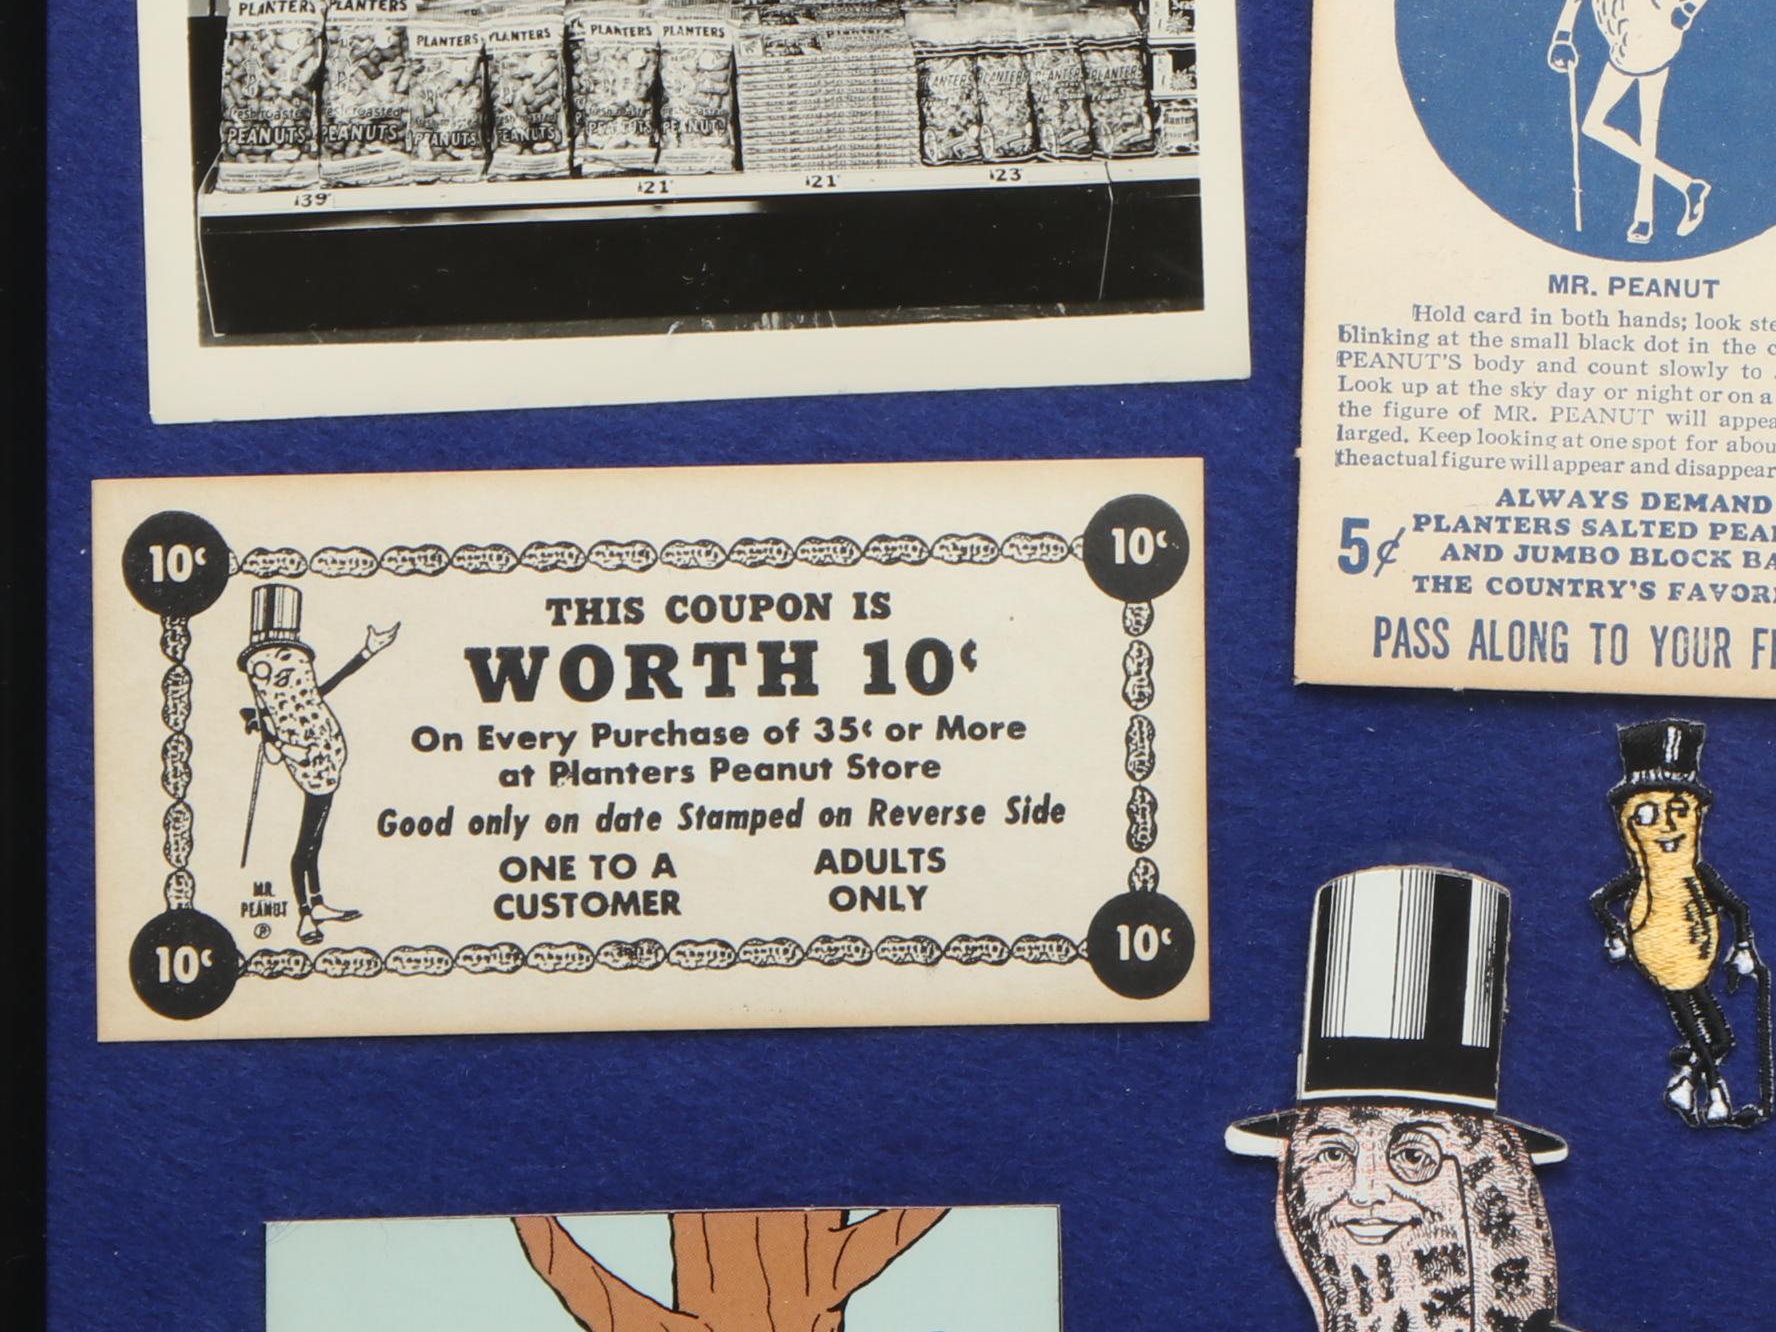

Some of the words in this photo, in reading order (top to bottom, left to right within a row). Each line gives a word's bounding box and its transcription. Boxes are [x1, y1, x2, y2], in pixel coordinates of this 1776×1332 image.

[228, 125, 306, 144] PEANUTS
[1547, 273, 1598, 297] MR.
[1607, 275, 1721, 300] PEANUT
[1411, 303, 1466, 323] Hold
[1473, 306, 1522, 325] card
[1530, 307, 1553, 326] in
[1560, 307, 1610, 328] both
[1617, 309, 1687, 331] hands;
[1695, 312, 1742, 332] look
[1337, 323, 1430, 347] blinking
[1437, 330, 1459, 347] at
[1468, 329, 1504, 349] the
[1510, 331, 1569, 350] small
[1578, 332, 1635, 352] black
[1643, 334, 1680, 354] dot
[1687, 336, 1709, 354] in
[1722, 337, 1757, 356] the
[1494, 487, 1629, 511] ALWAYS
[1639, 491, 1773, 515] DEMAND
[1411, 513, 1571, 537] PLANTERS
[1580, 518, 1699, 540] SALTED
[1439, 542, 1505, 563] AND
[1512, 543, 1621, 566] JUMBO
[1628, 546, 1733, 570] BLOCK
[1411, 574, 1473, 595] THE
[1485, 576, 1657, 601] COUNTRY'S
[544, 595, 646, 628] THIS
[664, 591, 834, 625] COUPON
[851, 590, 893, 621] IS
[1372, 615, 1451, 661] PASS
[1467, 618, 1569, 665] ALONG
[1588, 621, 1629, 667] TO
[1649, 624, 1732, 670] YOUR
[463, 638, 820, 704] WORTH
[410, 724, 464, 754] On
[476, 723, 579, 754] Every
[590, 718, 750, 749] Purchase
[762, 716, 801, 746] of
[884, 721, 924, 743] or
[935, 714, 1028, 742] More
[497, 763, 536, 789] at
[548, 758, 696, 789] Planters
[709, 756, 834, 784] Peanut
[846, 752, 942, 781] Store
[376, 804, 456, 839] Good
[467, 802, 531, 842] only
[543, 812, 580, 835] on
[594, 800, 663, 834] date
[676, 796, 806, 837] Stamped
[817, 805, 853, 829] on
[867, 796, 987, 828] Reverse
[1003, 791, 1067, 826] Side
[498, 854, 577, 884] ONE
[588, 852, 638, 882] TO
[650, 851, 678, 880] A
[813, 845, 947, 876] ADULTS
[240, 900, 289, 919] PEANUT
[492, 888, 683, 922] CUSTOMER
[827, 883, 929, 913] ONLY
